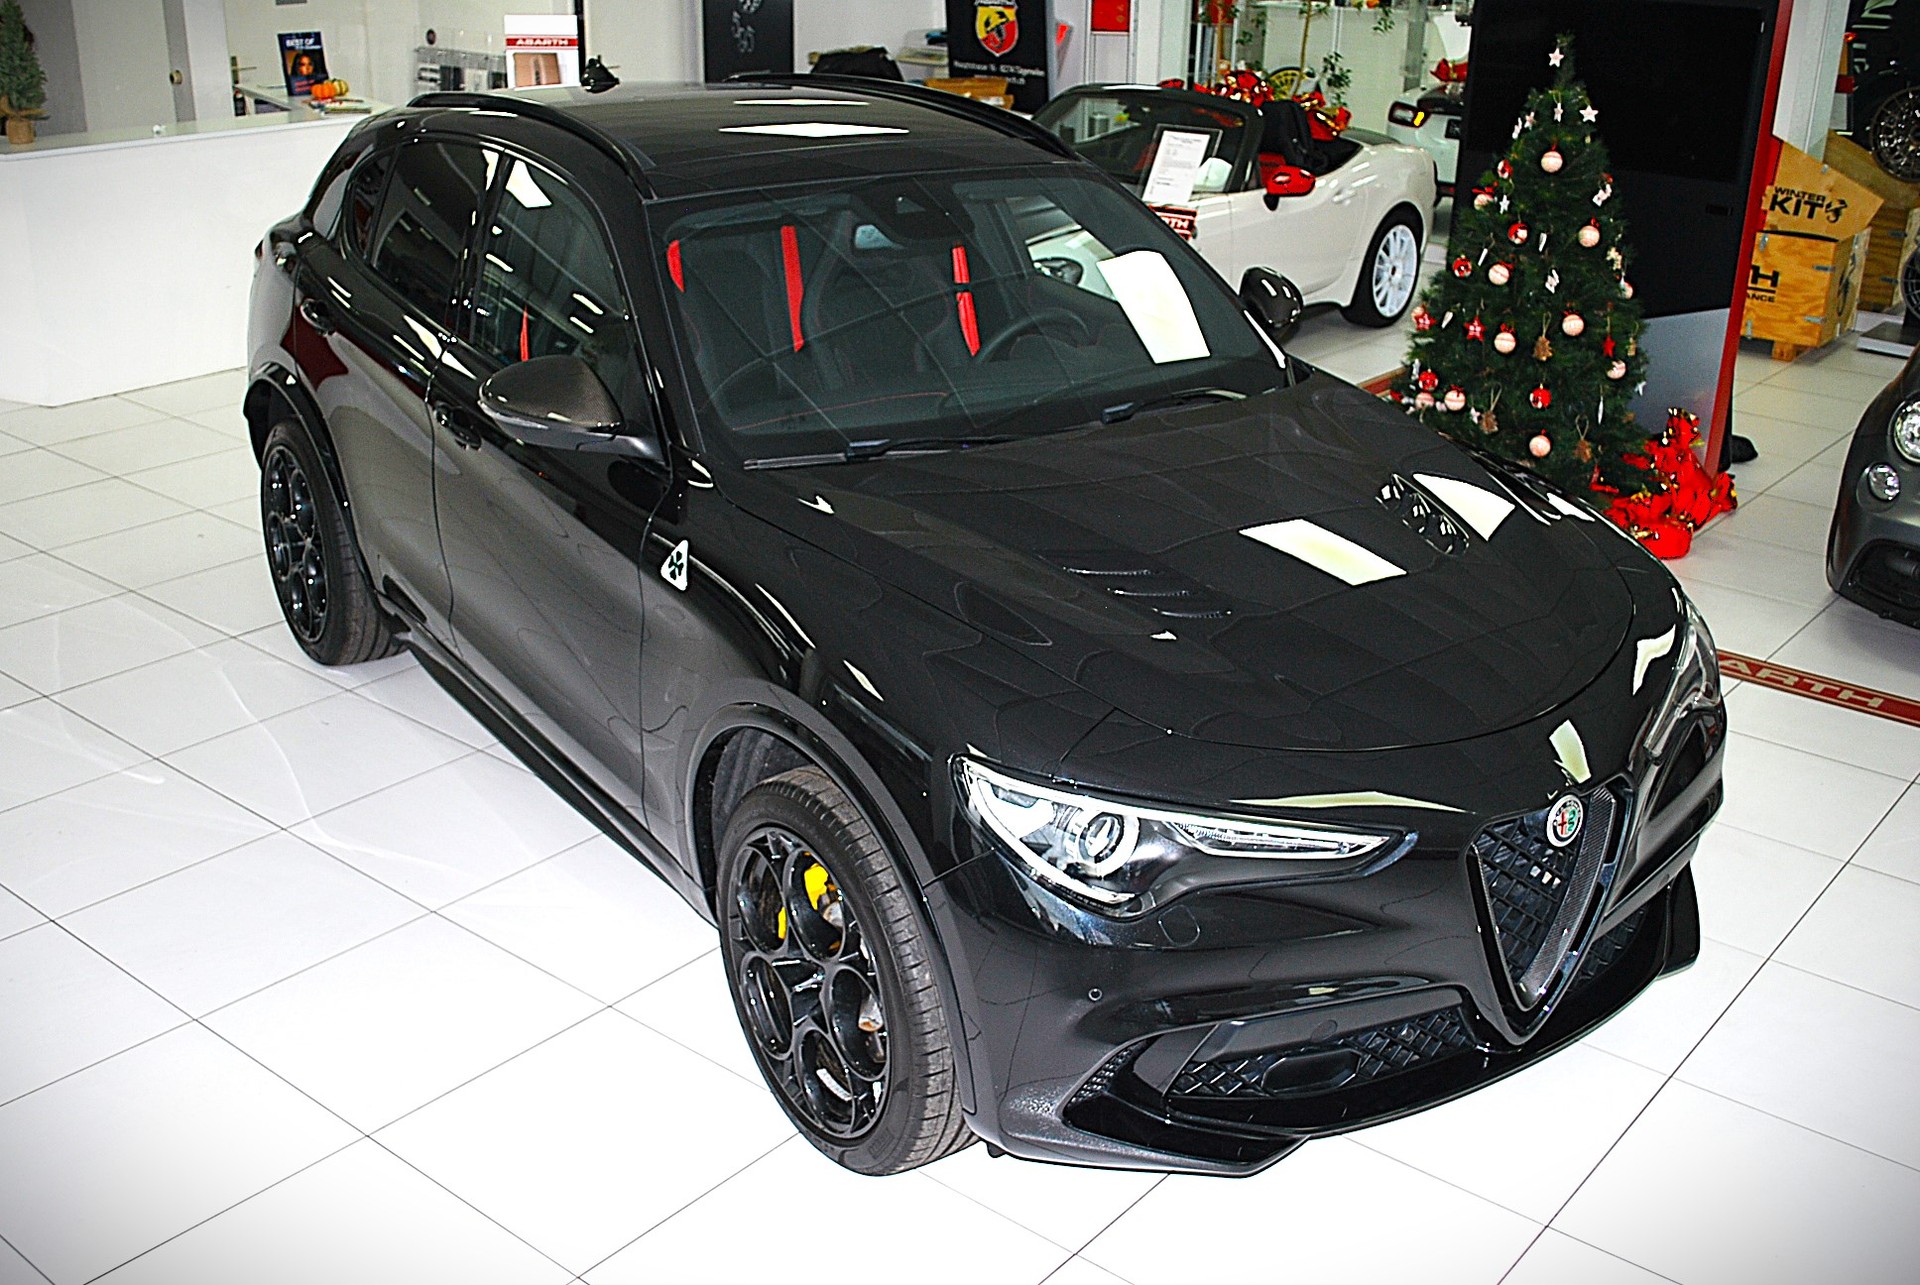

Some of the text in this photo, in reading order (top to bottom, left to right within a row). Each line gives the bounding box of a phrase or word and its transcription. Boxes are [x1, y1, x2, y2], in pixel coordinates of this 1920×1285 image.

[1769, 194, 1825, 219] KIT
[1774, 186, 1826, 202] WINTER
[1719, 658, 1884, 709] ARTH
